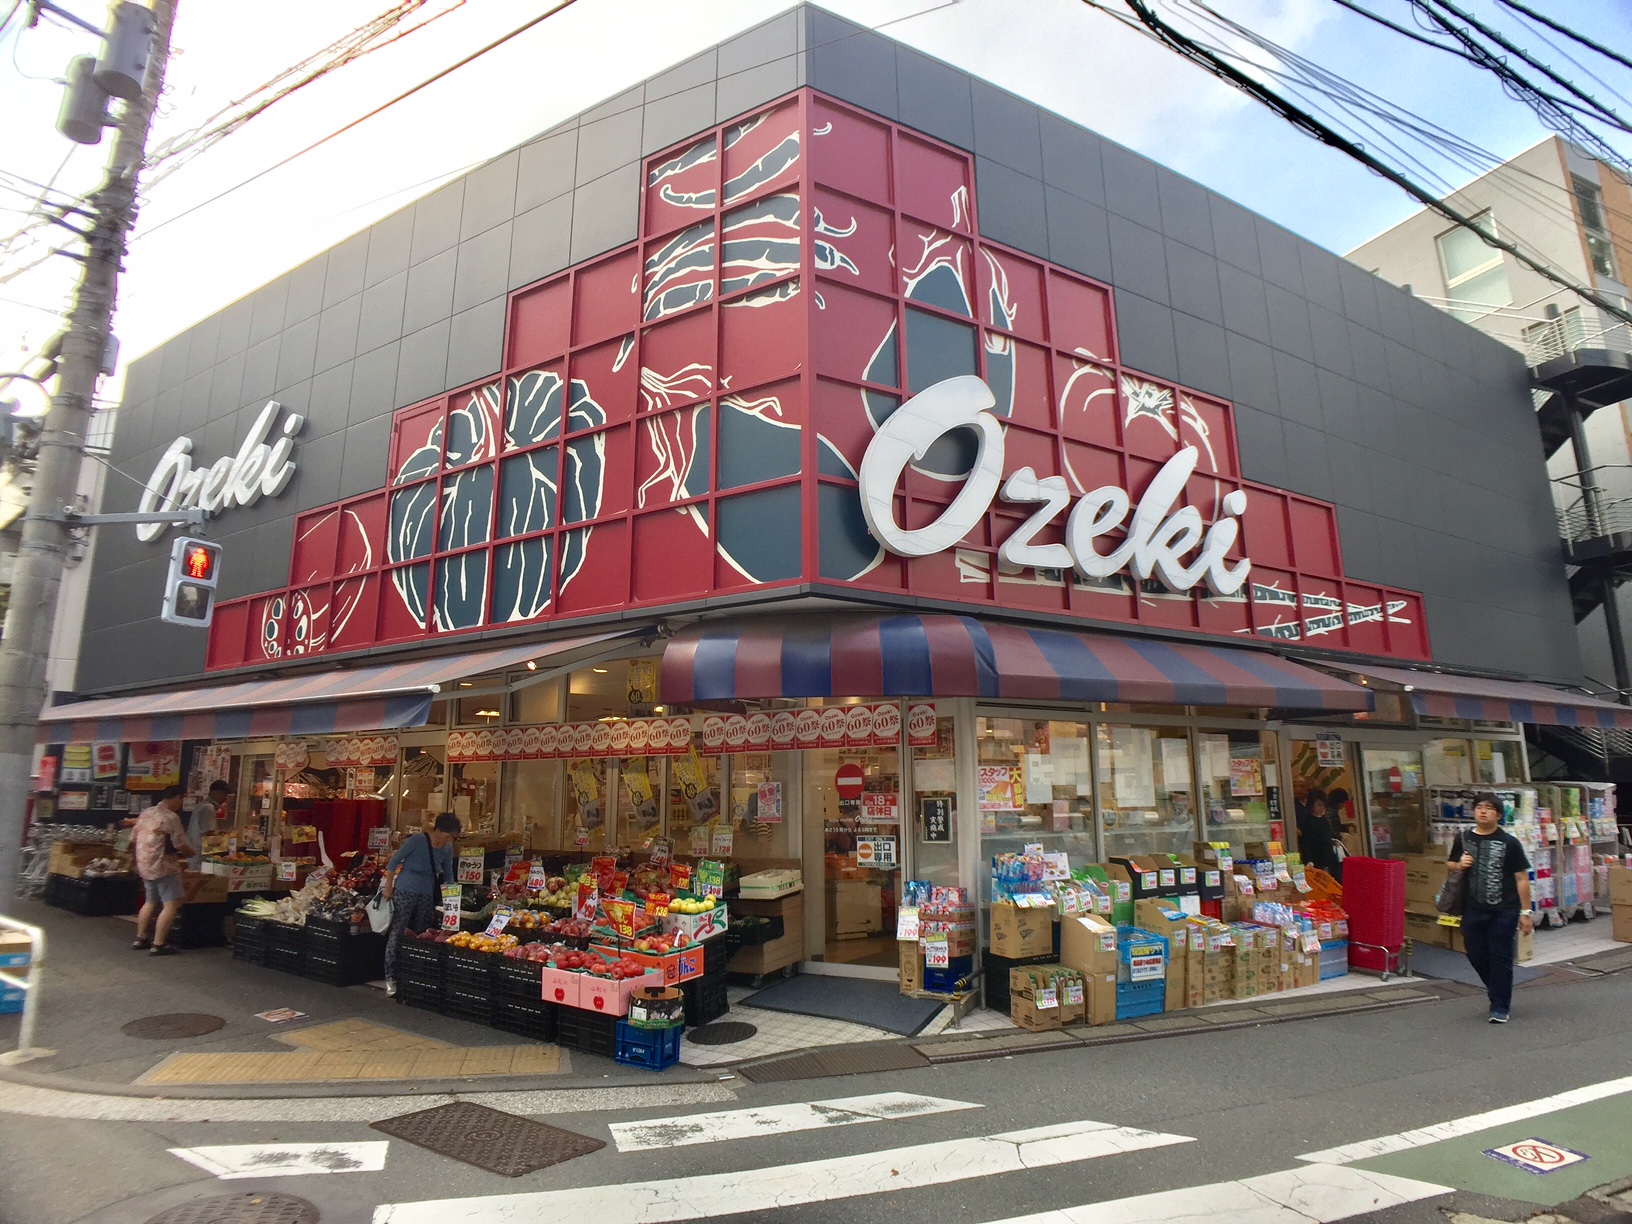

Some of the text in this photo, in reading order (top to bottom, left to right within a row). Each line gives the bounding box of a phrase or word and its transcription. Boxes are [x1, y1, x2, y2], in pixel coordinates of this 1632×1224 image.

[136, 400, 304, 542] Ozeki
[859, 375, 1251, 596] Ozeki
[797, 720, 819, 734] 60祭
[821, 718, 845, 733] 60祭
[847, 716, 871, 732] 60祭
[874, 714, 898, 730] 60祭
[909, 715, 934, 731] 60祭
[650, 728, 669, 742] 60祭
[670, 728, 690, 740] 60祭
[704, 726, 724, 740] 60祭
[726, 725, 746, 739] 60祭
[748, 723, 770, 737] 60祭
[772, 722, 794, 736] 60祭
[575, 733, 592, 745] 60祭
[593, 732, 610, 744] 60祭
[611, 730, 629, 743] 60祭
[630, 730, 648, 742] 60祭
[980, 767, 1008, 777] スタッフ
[867, 806, 892, 816] 店休日
[936, 800, 944, 832] 特別警戒
[874, 842, 891, 851] 出口
[874, 853, 892, 862] 専用
[655, 906, 667, 915] 138
[444, 915, 457, 926] 98
[619, 924, 632, 934] 138
[928, 955, 946, 963] ¥199
